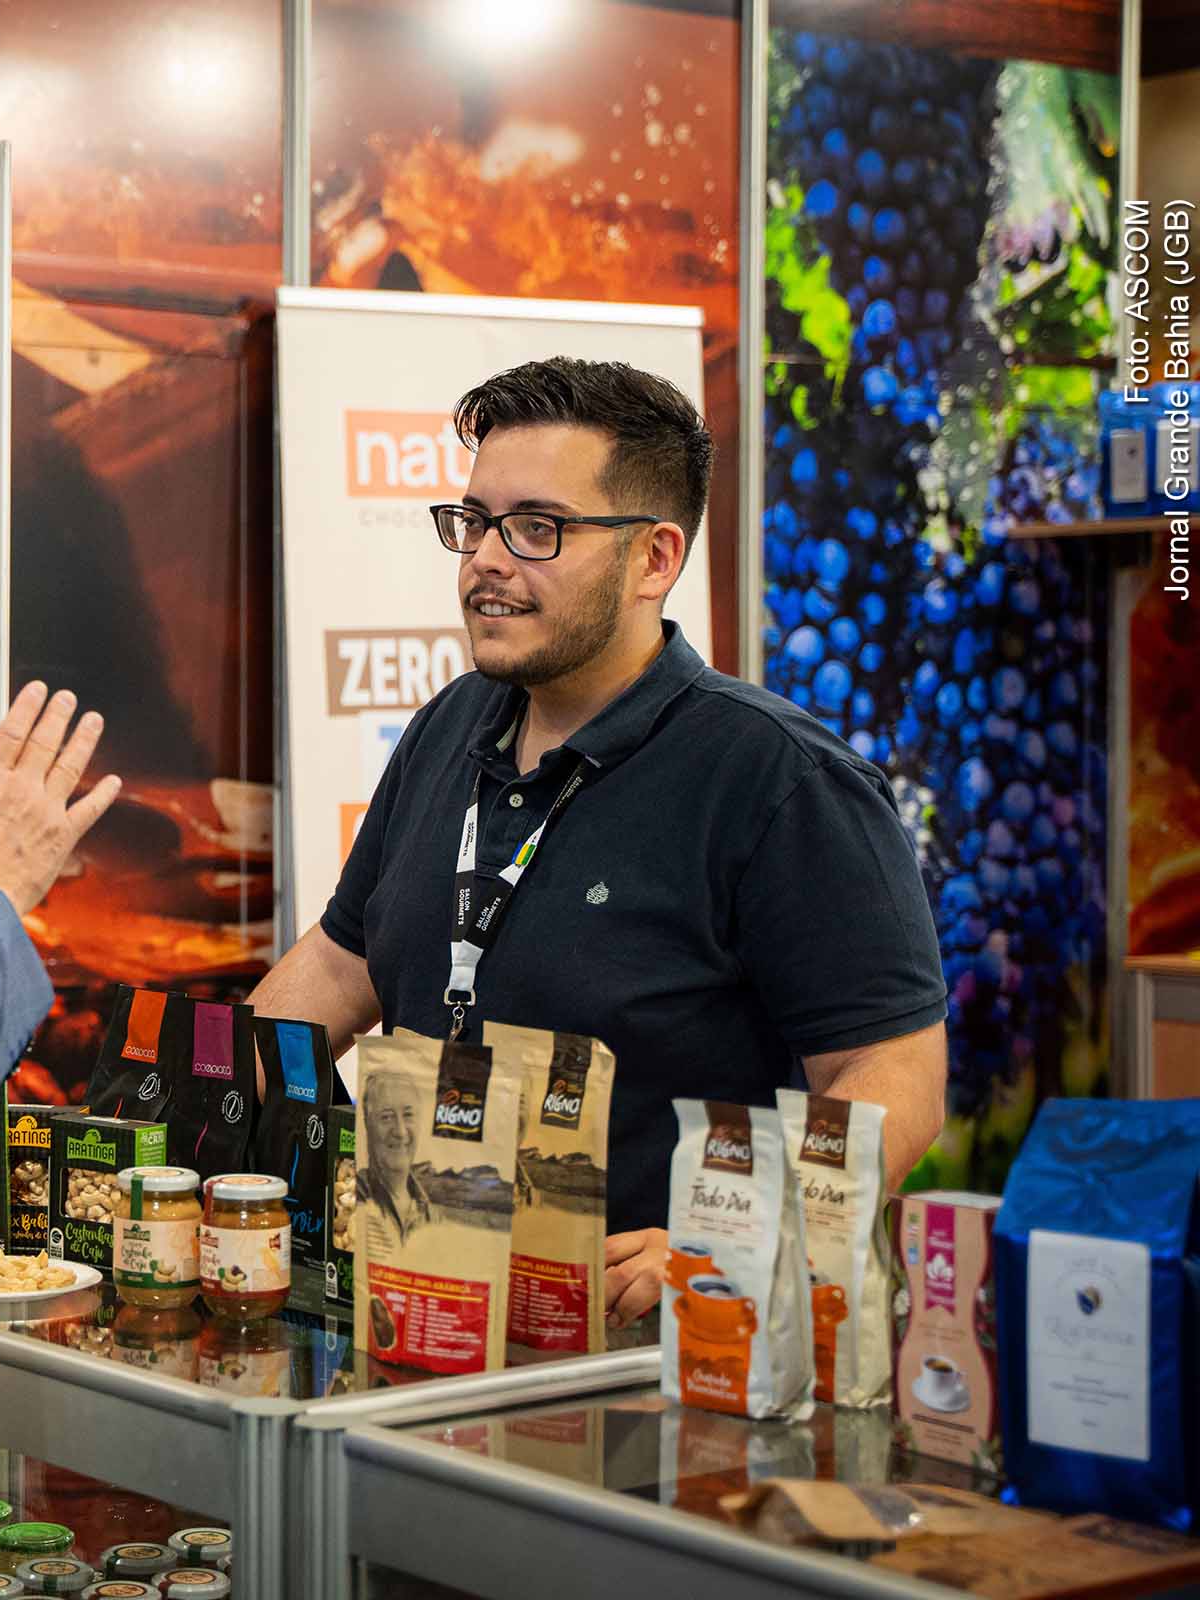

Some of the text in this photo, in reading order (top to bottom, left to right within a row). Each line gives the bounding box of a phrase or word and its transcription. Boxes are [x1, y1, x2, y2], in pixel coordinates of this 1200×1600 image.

[355, 421, 472, 488] nat
[338, 636, 465, 706] ZERO
[481, 897, 502, 931] GOURMETS
[8, 1130, 51, 1145] RATINGA
[67, 1142, 115, 1162] ARATINGA
[21, 1212, 48, 1231] Bahi
[81, 1243, 105, 1264] Caju
